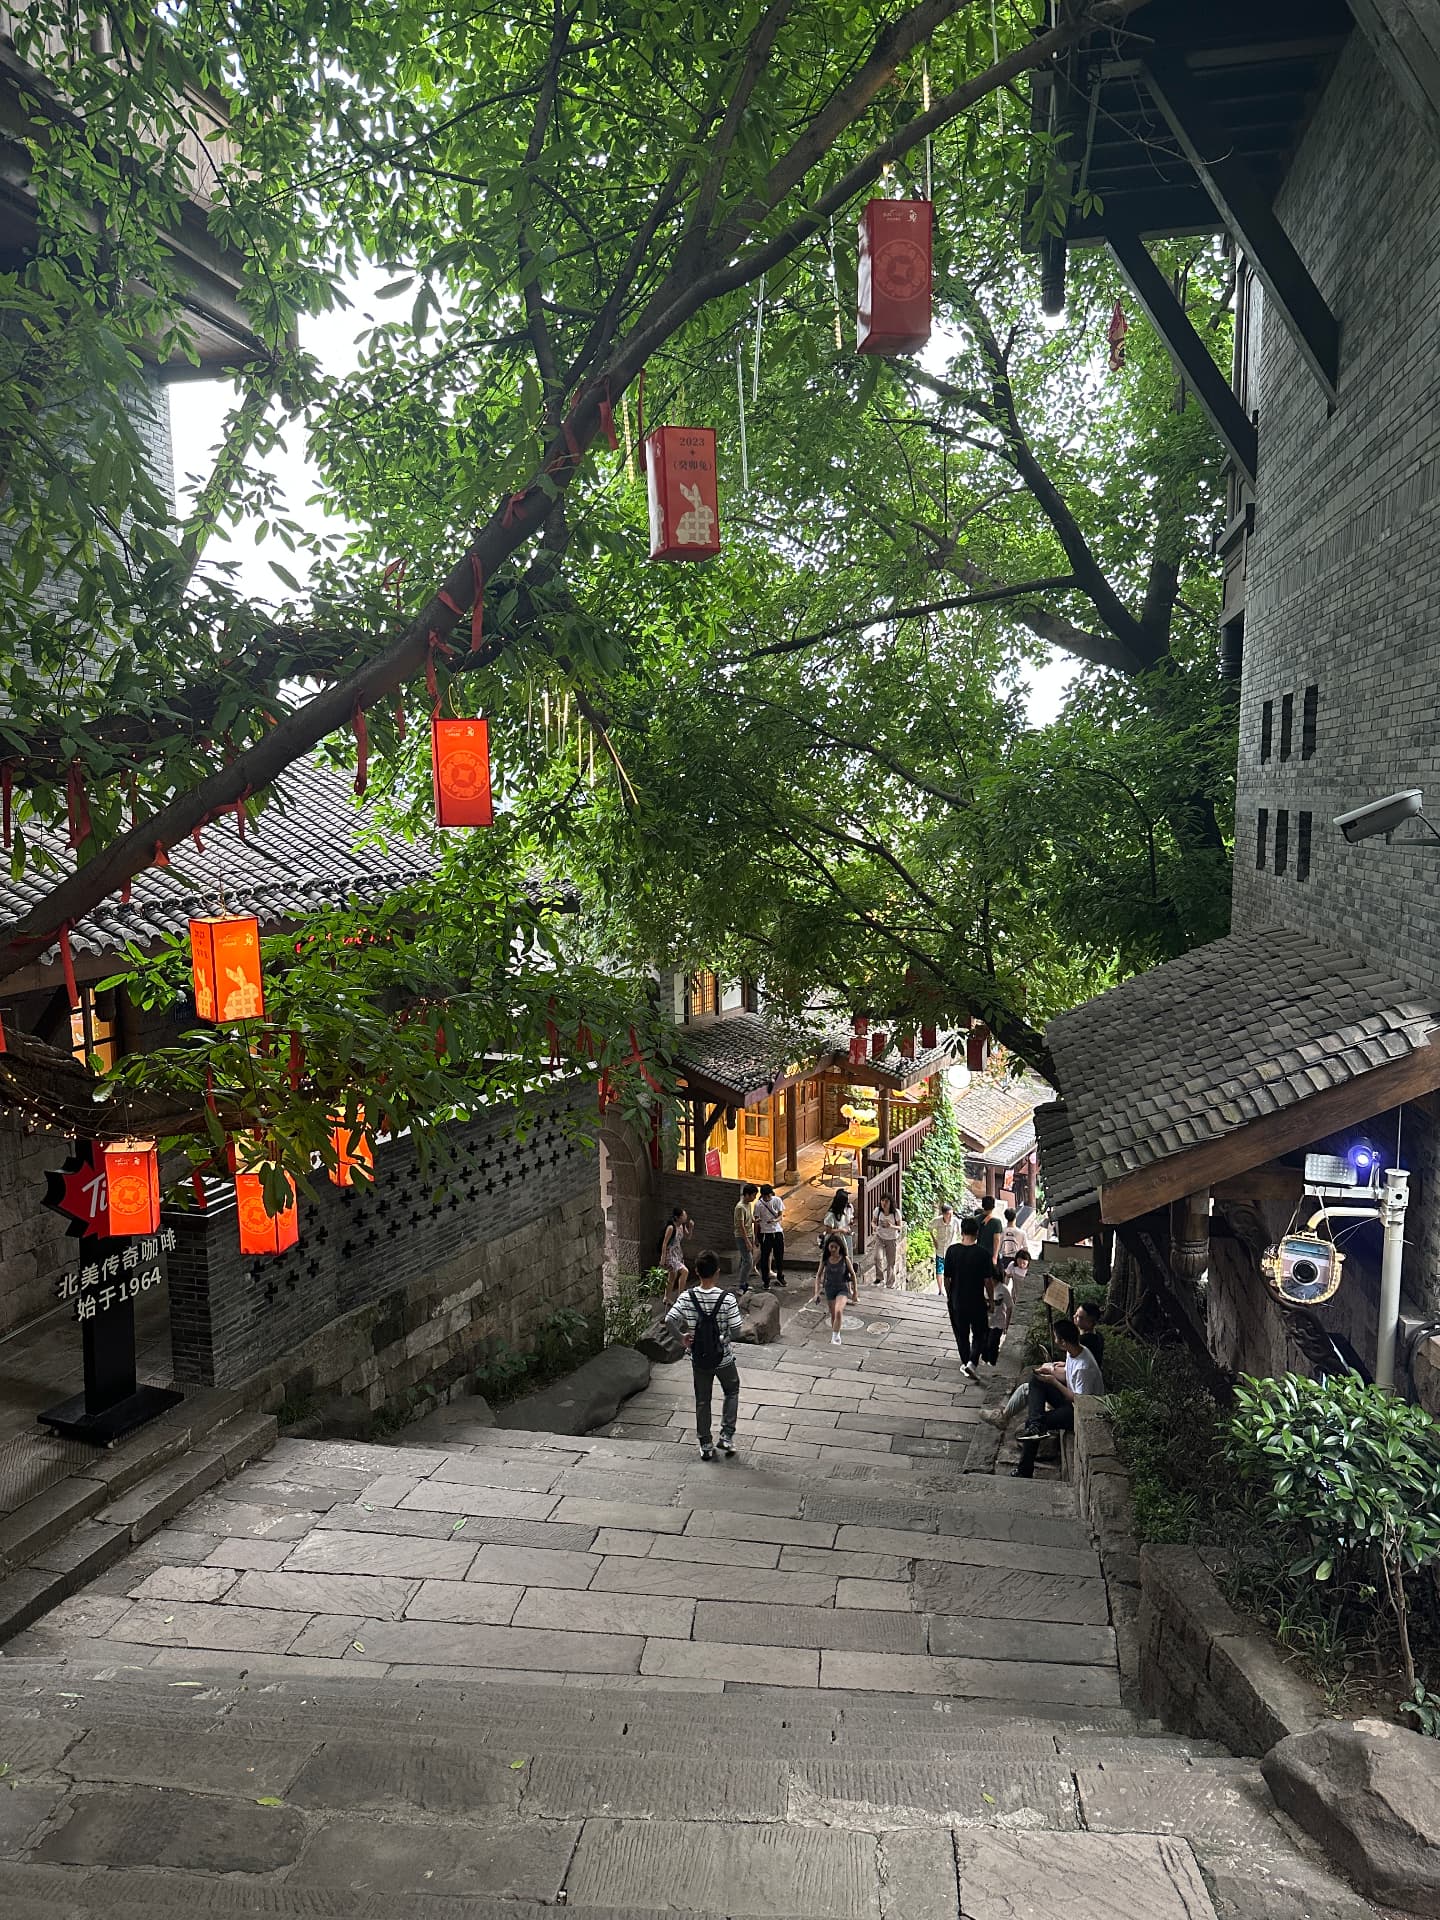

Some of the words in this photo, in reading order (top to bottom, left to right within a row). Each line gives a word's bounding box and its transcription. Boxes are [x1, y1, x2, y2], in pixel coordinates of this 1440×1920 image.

[680, 437, 705, 446] 2023
[81, 1172, 107, 1218] Ti
[58, 1227, 177, 1299] 北美传奇咖啡
[77, 1266, 162, 1322] 始于1964
